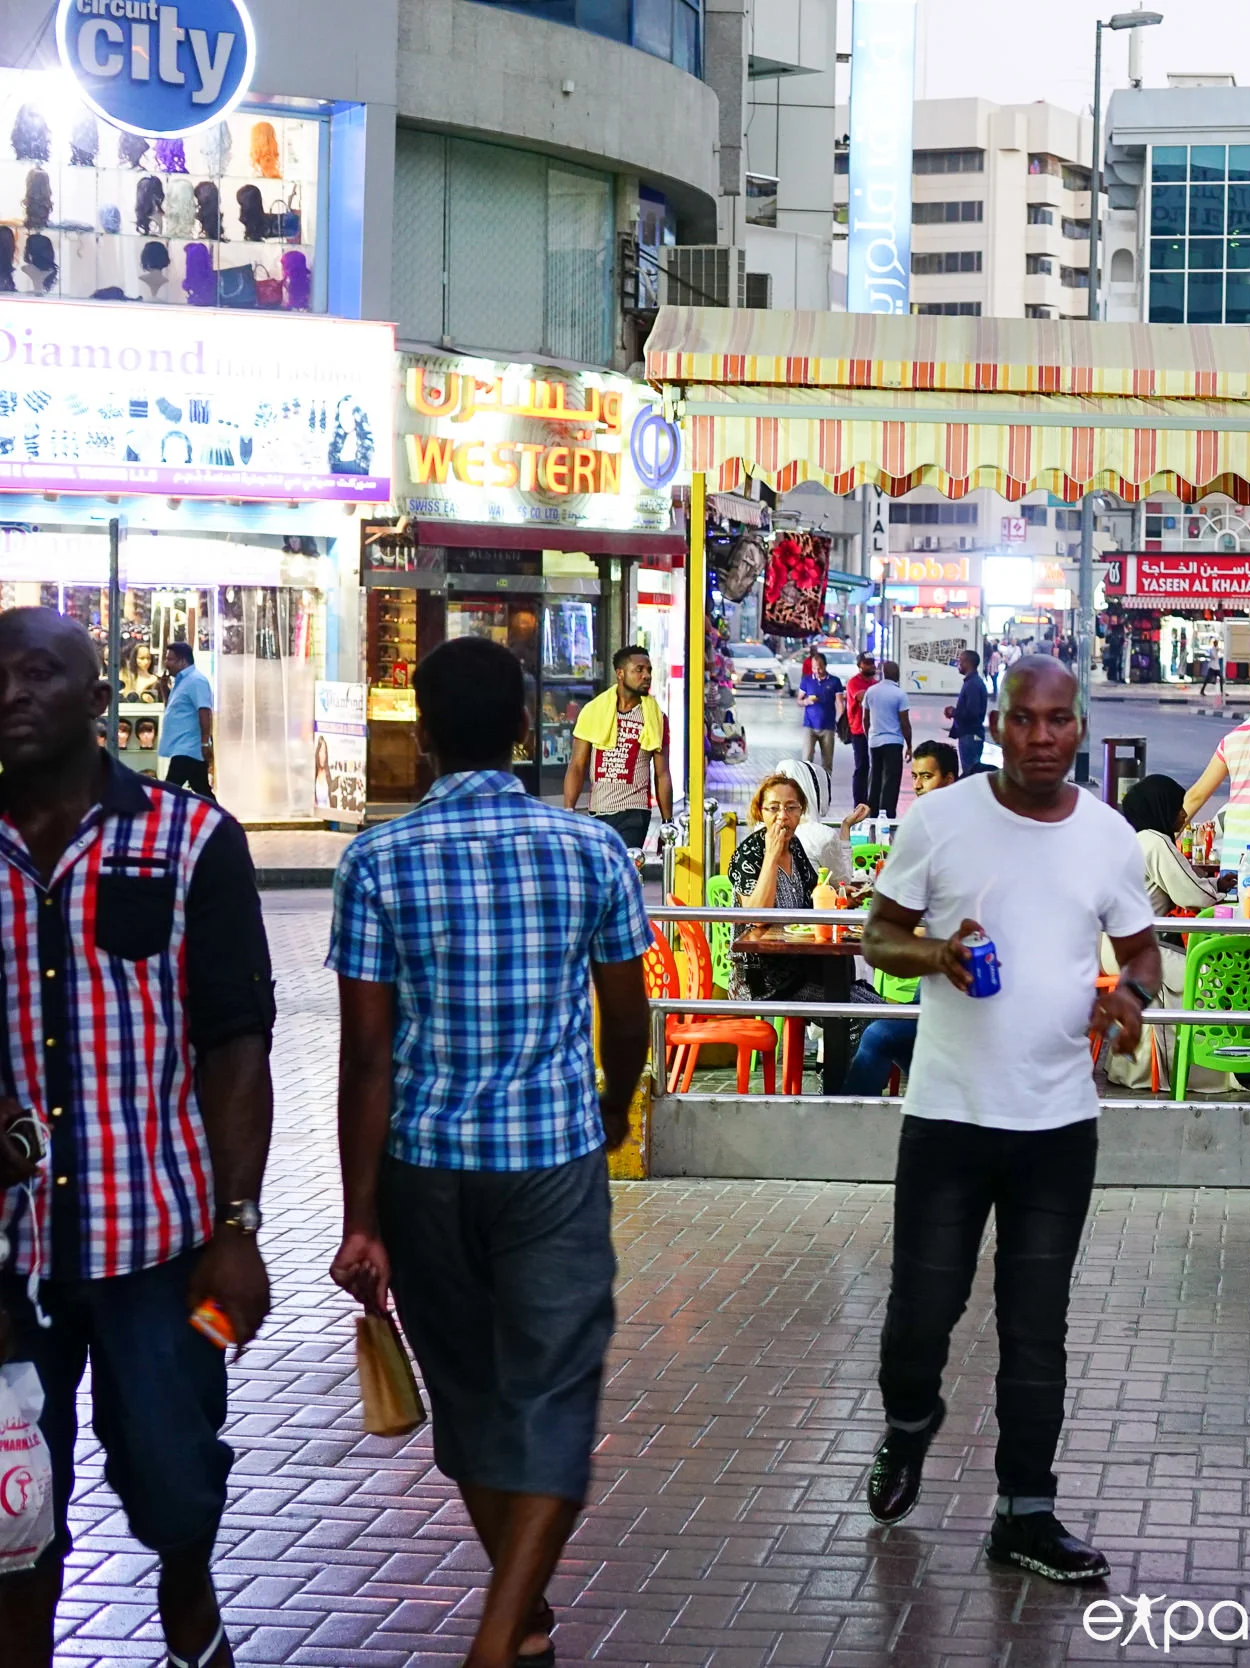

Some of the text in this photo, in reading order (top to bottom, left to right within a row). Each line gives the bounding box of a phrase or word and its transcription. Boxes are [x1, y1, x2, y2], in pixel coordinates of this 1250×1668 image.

[77, 0, 159, 20] circuit
[77, 6, 236, 105] city
[0, 328, 206, 376] Diamond
[404, 433, 622, 496] WESTERN
[409, 499, 440, 513] SWISS
[892, 557, 970, 583] Nobel
[1141, 560, 1197, 576] الخاجة
[1141, 577, 1190, 593] YASEEN
[1192, 578, 1210, 593] AL
